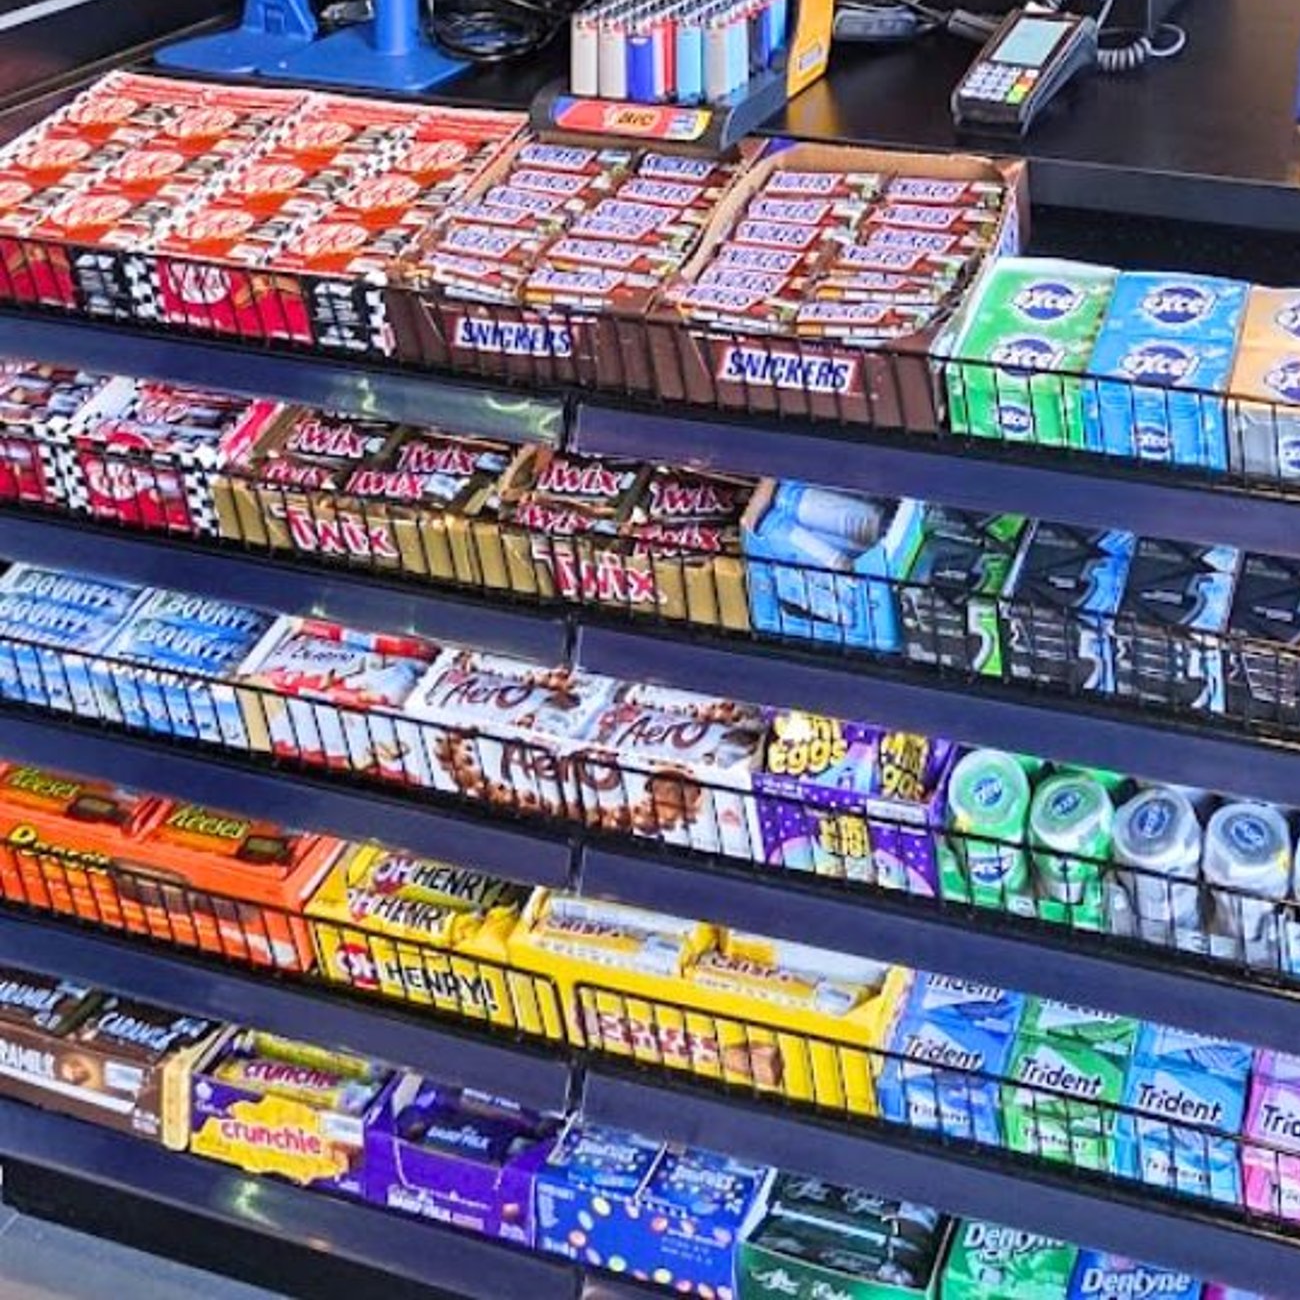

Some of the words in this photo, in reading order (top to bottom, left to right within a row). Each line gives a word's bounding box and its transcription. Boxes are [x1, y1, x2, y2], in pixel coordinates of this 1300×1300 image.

[1011, 284, 1086, 313] excel
[1142, 287, 1216, 317] excel
[460, 320, 572, 355] SNICKERS
[991, 340, 1066, 369] excel
[724, 353, 849, 390] SNICKERS
[1120, 348, 1200, 380] excel
[22, 572, 115, 607] BOUNTY
[906, 1034, 983, 1071] Trident
[1020, 1056, 1103, 1096] Trident
[1138, 1082, 1223, 1123] Trident
[220, 1117, 322, 1156] crunchie
[1081, 1268, 1191, 1299] Dentyne
